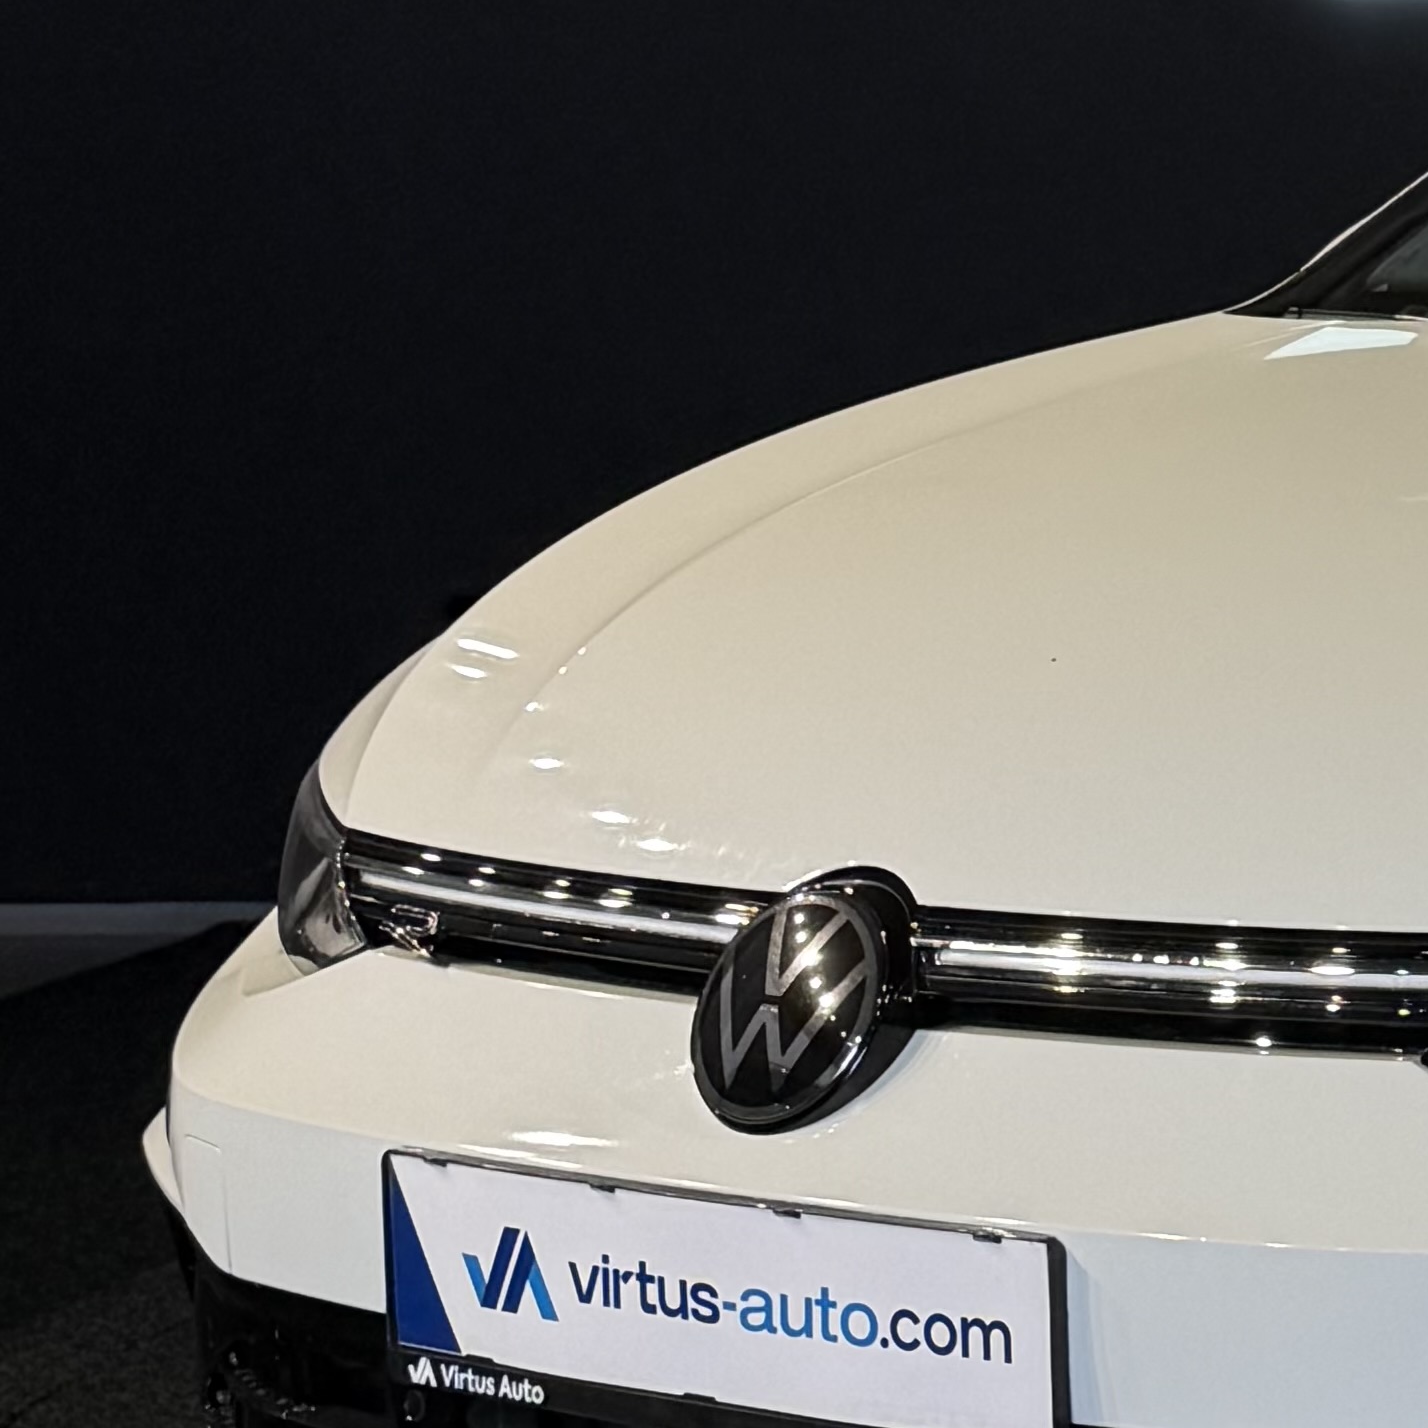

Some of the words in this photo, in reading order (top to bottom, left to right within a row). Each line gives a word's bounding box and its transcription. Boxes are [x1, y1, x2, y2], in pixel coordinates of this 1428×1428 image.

[568, 1253, 1013, 1365] virtus-auto.com
[440, 1363, 496, 1396] Virtus
[498, 1374, 545, 1405] Auto
